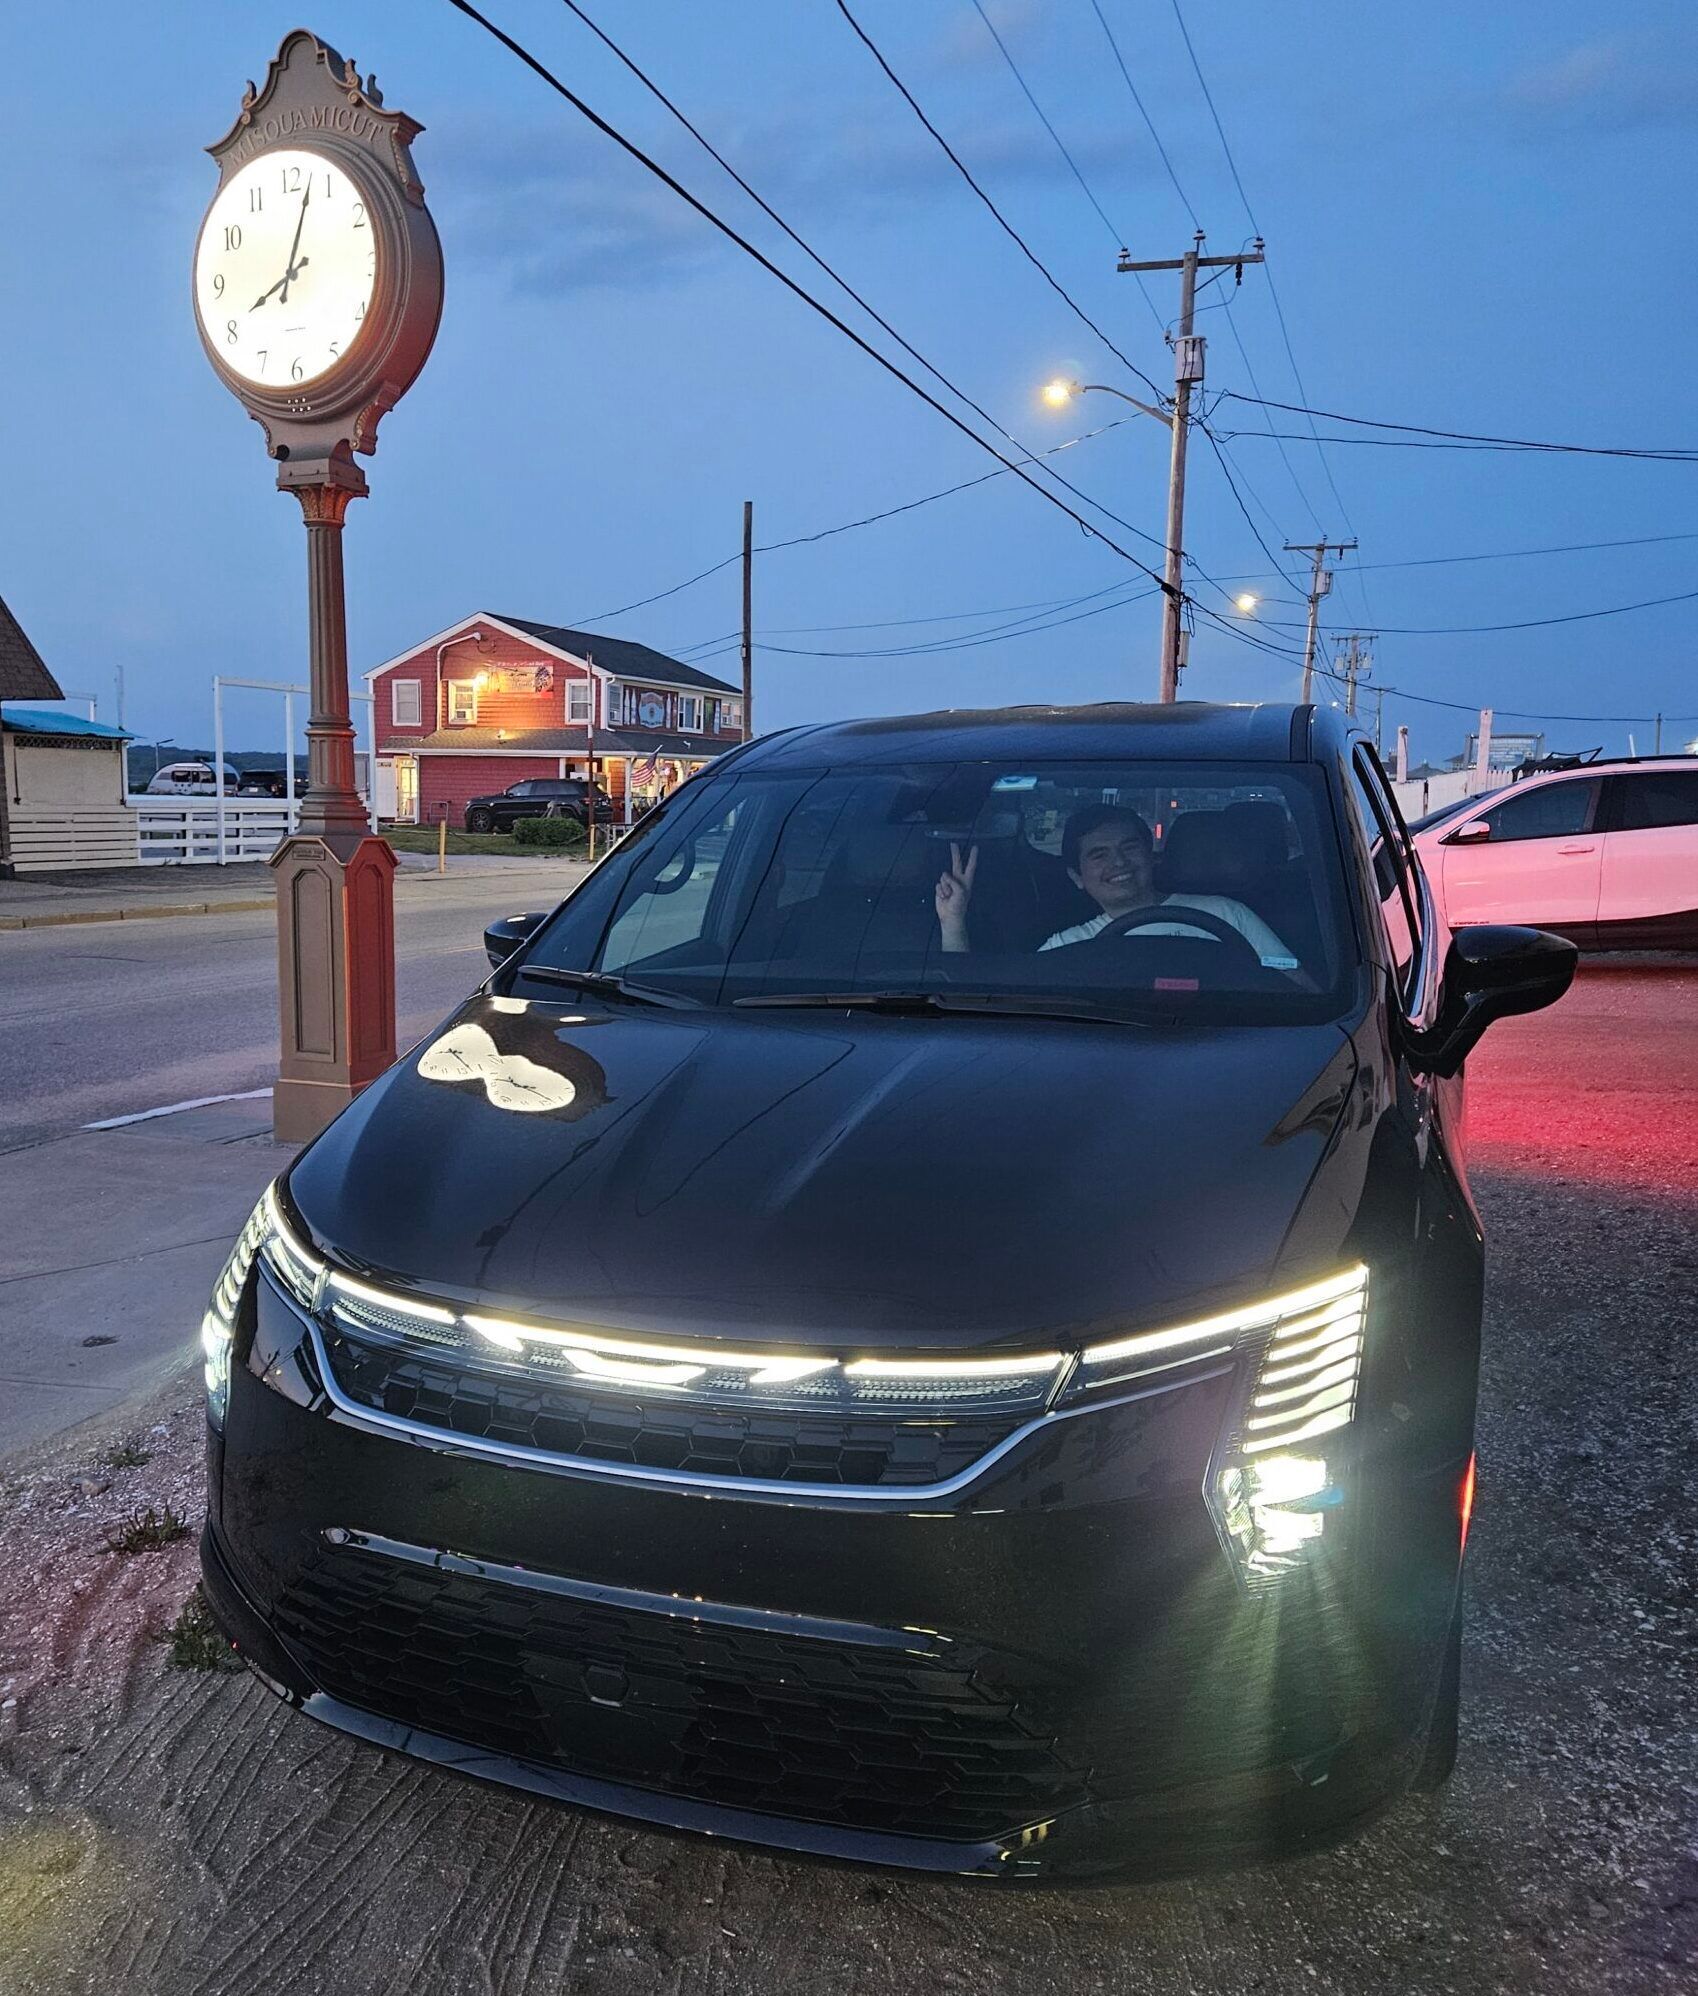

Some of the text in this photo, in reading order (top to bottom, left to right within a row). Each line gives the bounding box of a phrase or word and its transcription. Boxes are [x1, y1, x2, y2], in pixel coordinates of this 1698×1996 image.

[228, 104, 384, 167] MISQUAMICUT
[281, 166, 302, 194] 12
[326, 174, 332, 198] 1
[249, 186, 263, 212] 11
[352, 202, 366, 229] 2
[223, 224, 242, 251] 10
[213, 273, 225, 300] 9
[227, 319, 238, 345] 8
[256, 350, 268, 375] 7
[291, 356, 303, 382] 6
